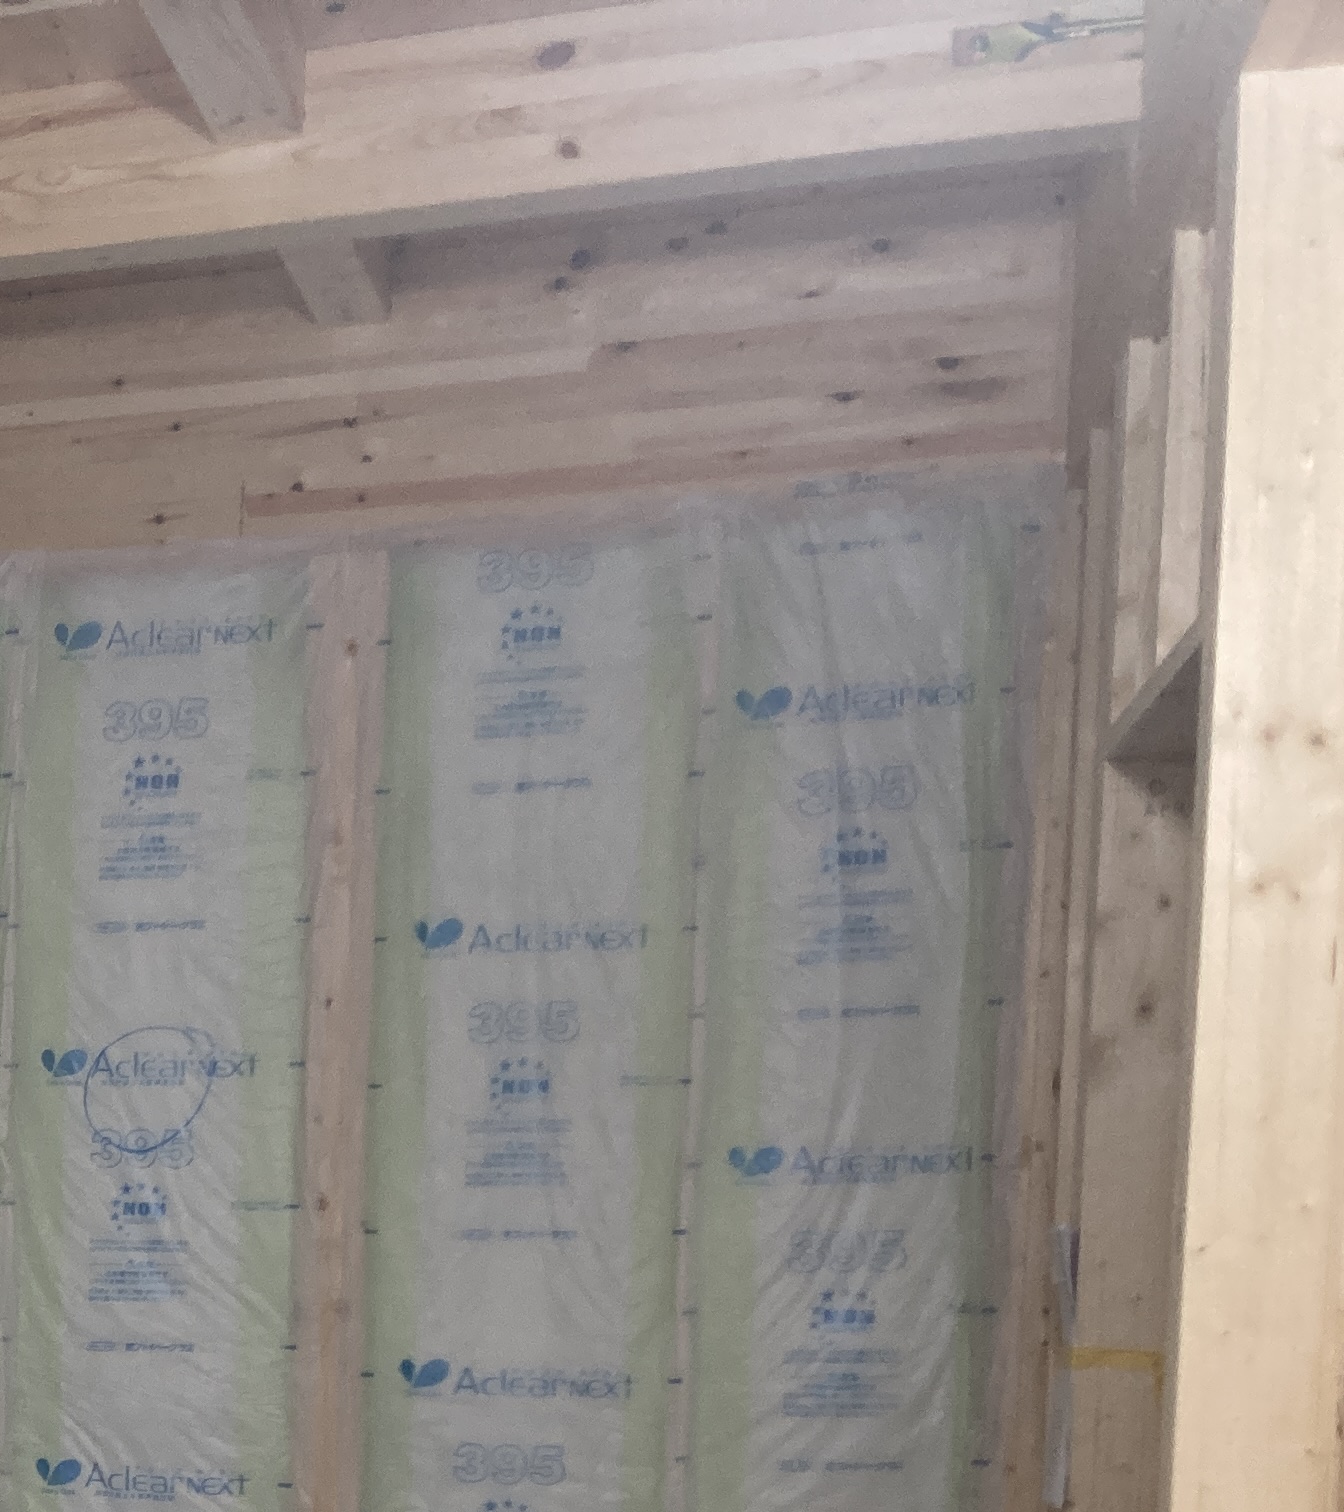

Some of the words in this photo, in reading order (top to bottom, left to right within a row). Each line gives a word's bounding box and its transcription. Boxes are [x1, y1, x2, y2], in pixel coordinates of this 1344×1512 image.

[102, 697, 210, 742] 395
[134, 772, 180, 791] NON
[90, 1127, 195, 1169] 395
[122, 1201, 167, 1218] NON
[452, 1442, 567, 1485] 395
